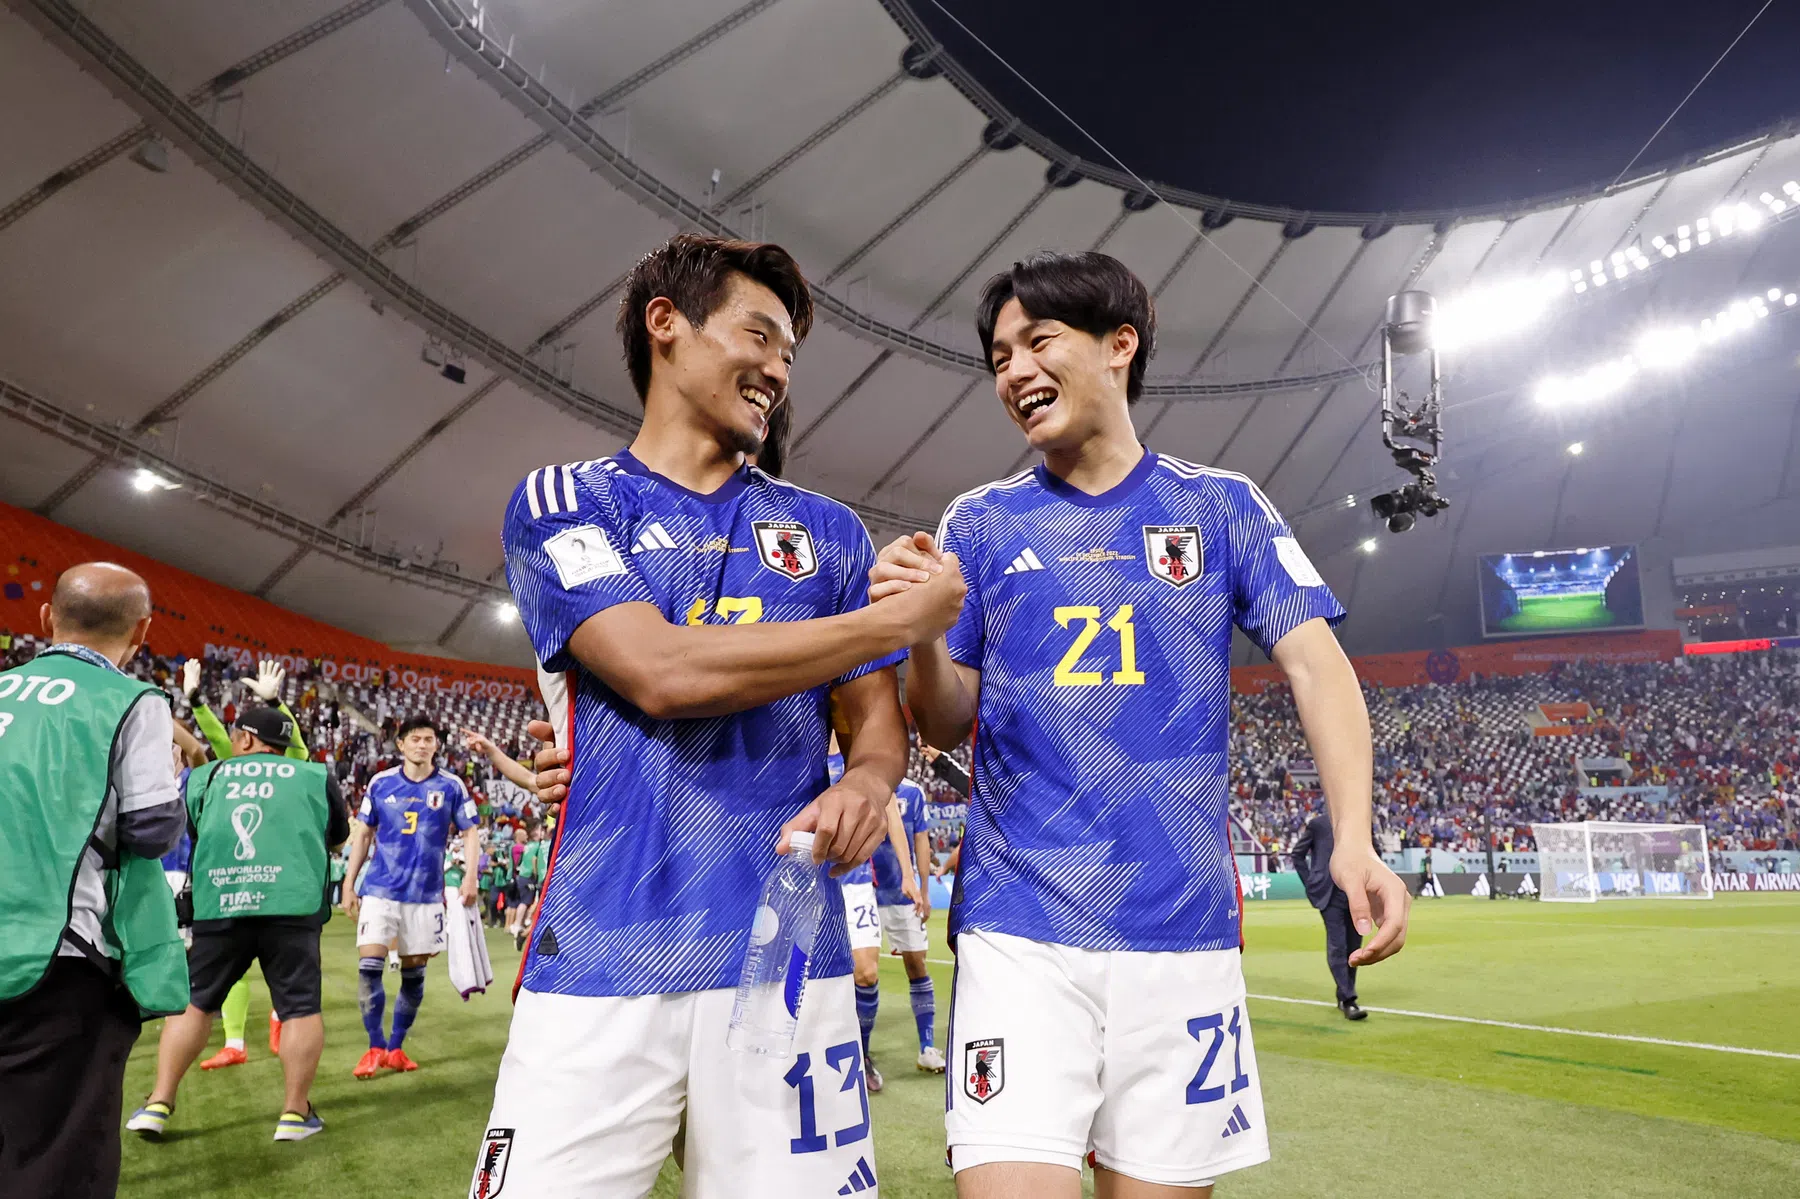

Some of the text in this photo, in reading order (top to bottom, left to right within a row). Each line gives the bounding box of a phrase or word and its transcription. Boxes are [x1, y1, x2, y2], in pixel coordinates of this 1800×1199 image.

[780, 559, 804, 570] JFA
[1165, 565, 1189, 576] JFA
[1053, 604, 1146, 687] 21
[256, 650, 337, 679] WORD
[225, 781, 274, 799] 240
[401, 811, 418, 834] 3
[208, 865, 283, 878] FIFA WORLD CUP
[1610, 873, 1641, 893] VISA
[1649, 873, 1681, 893] VISA
[1701, 872, 1750, 892] QATAR
[434, 913, 444, 935] 3
[972, 1040, 995, 1049] JAPAN
[1186, 1005, 1249, 1105] 21
[783, 1040, 870, 1154] 13
[488, 1130, 505, 1138] JAPAN
